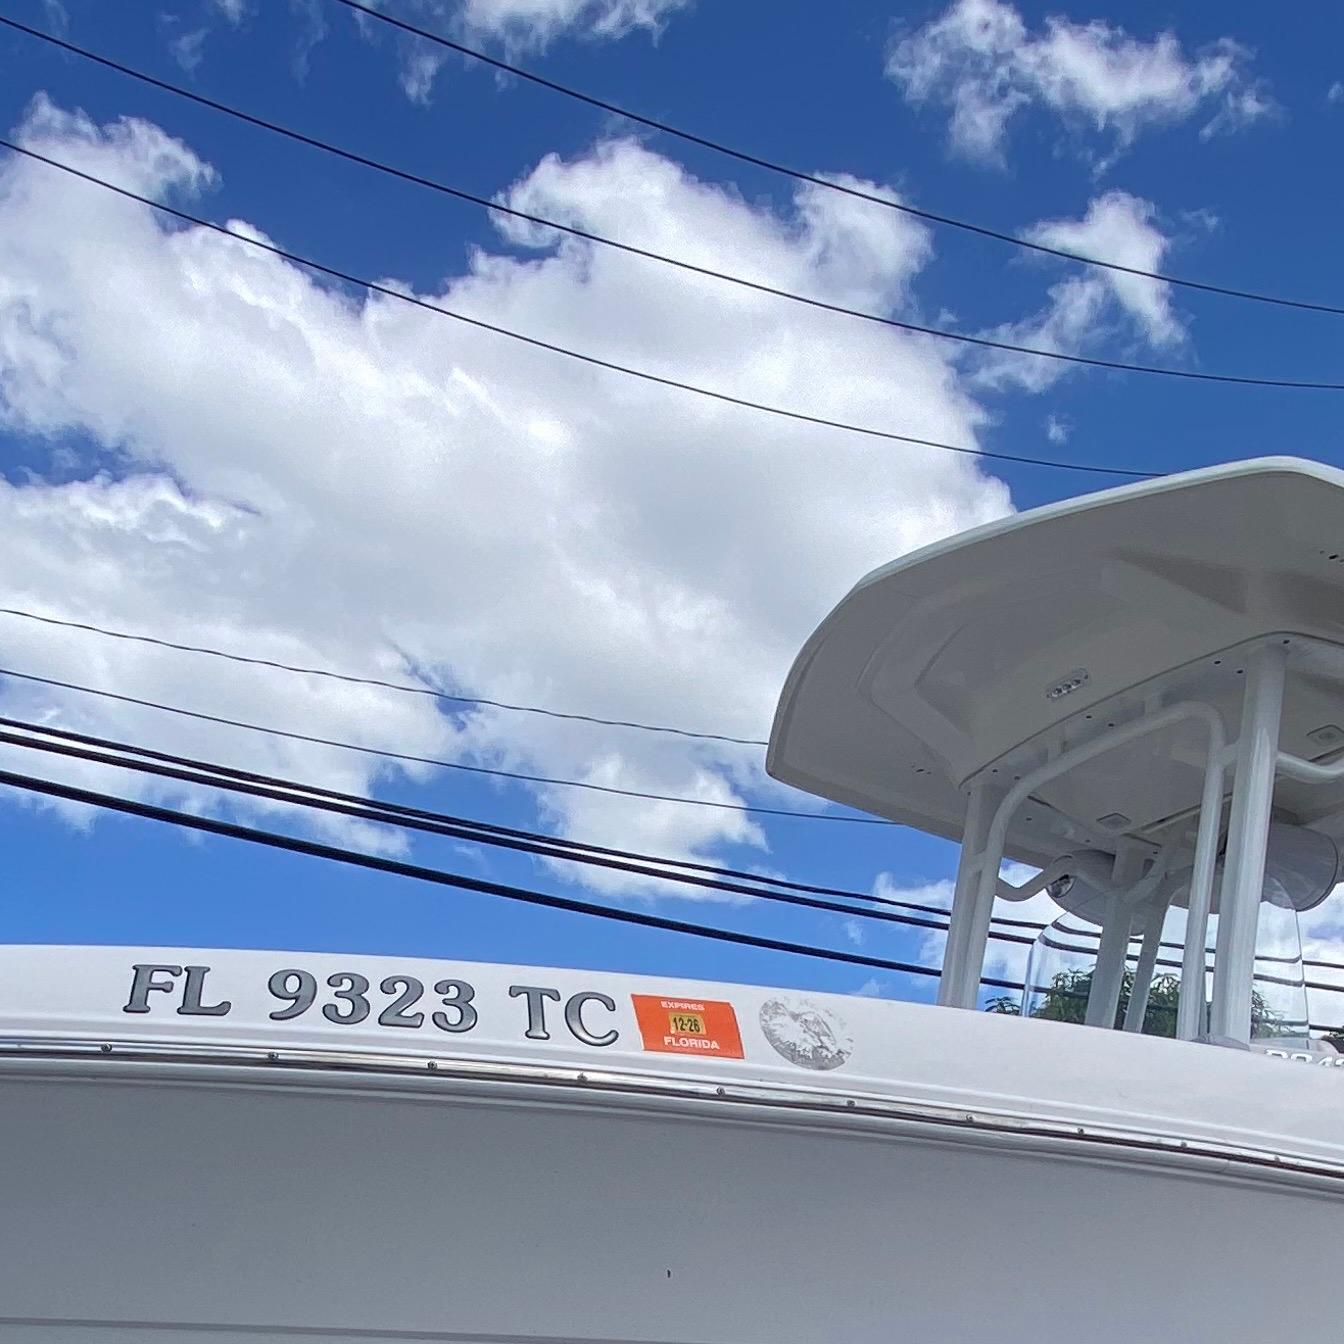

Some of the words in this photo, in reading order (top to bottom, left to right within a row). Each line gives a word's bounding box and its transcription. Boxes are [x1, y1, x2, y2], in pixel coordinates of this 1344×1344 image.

[122, 964, 233, 1016] FL
[267, 968, 479, 1034] 9323
[508, 985, 621, 1047] TC
[660, 1000, 705, 1011] EXPIRES
[672, 1015, 701, 1034] 12-26
[664, 1035, 721, 1051] FLORIDA
